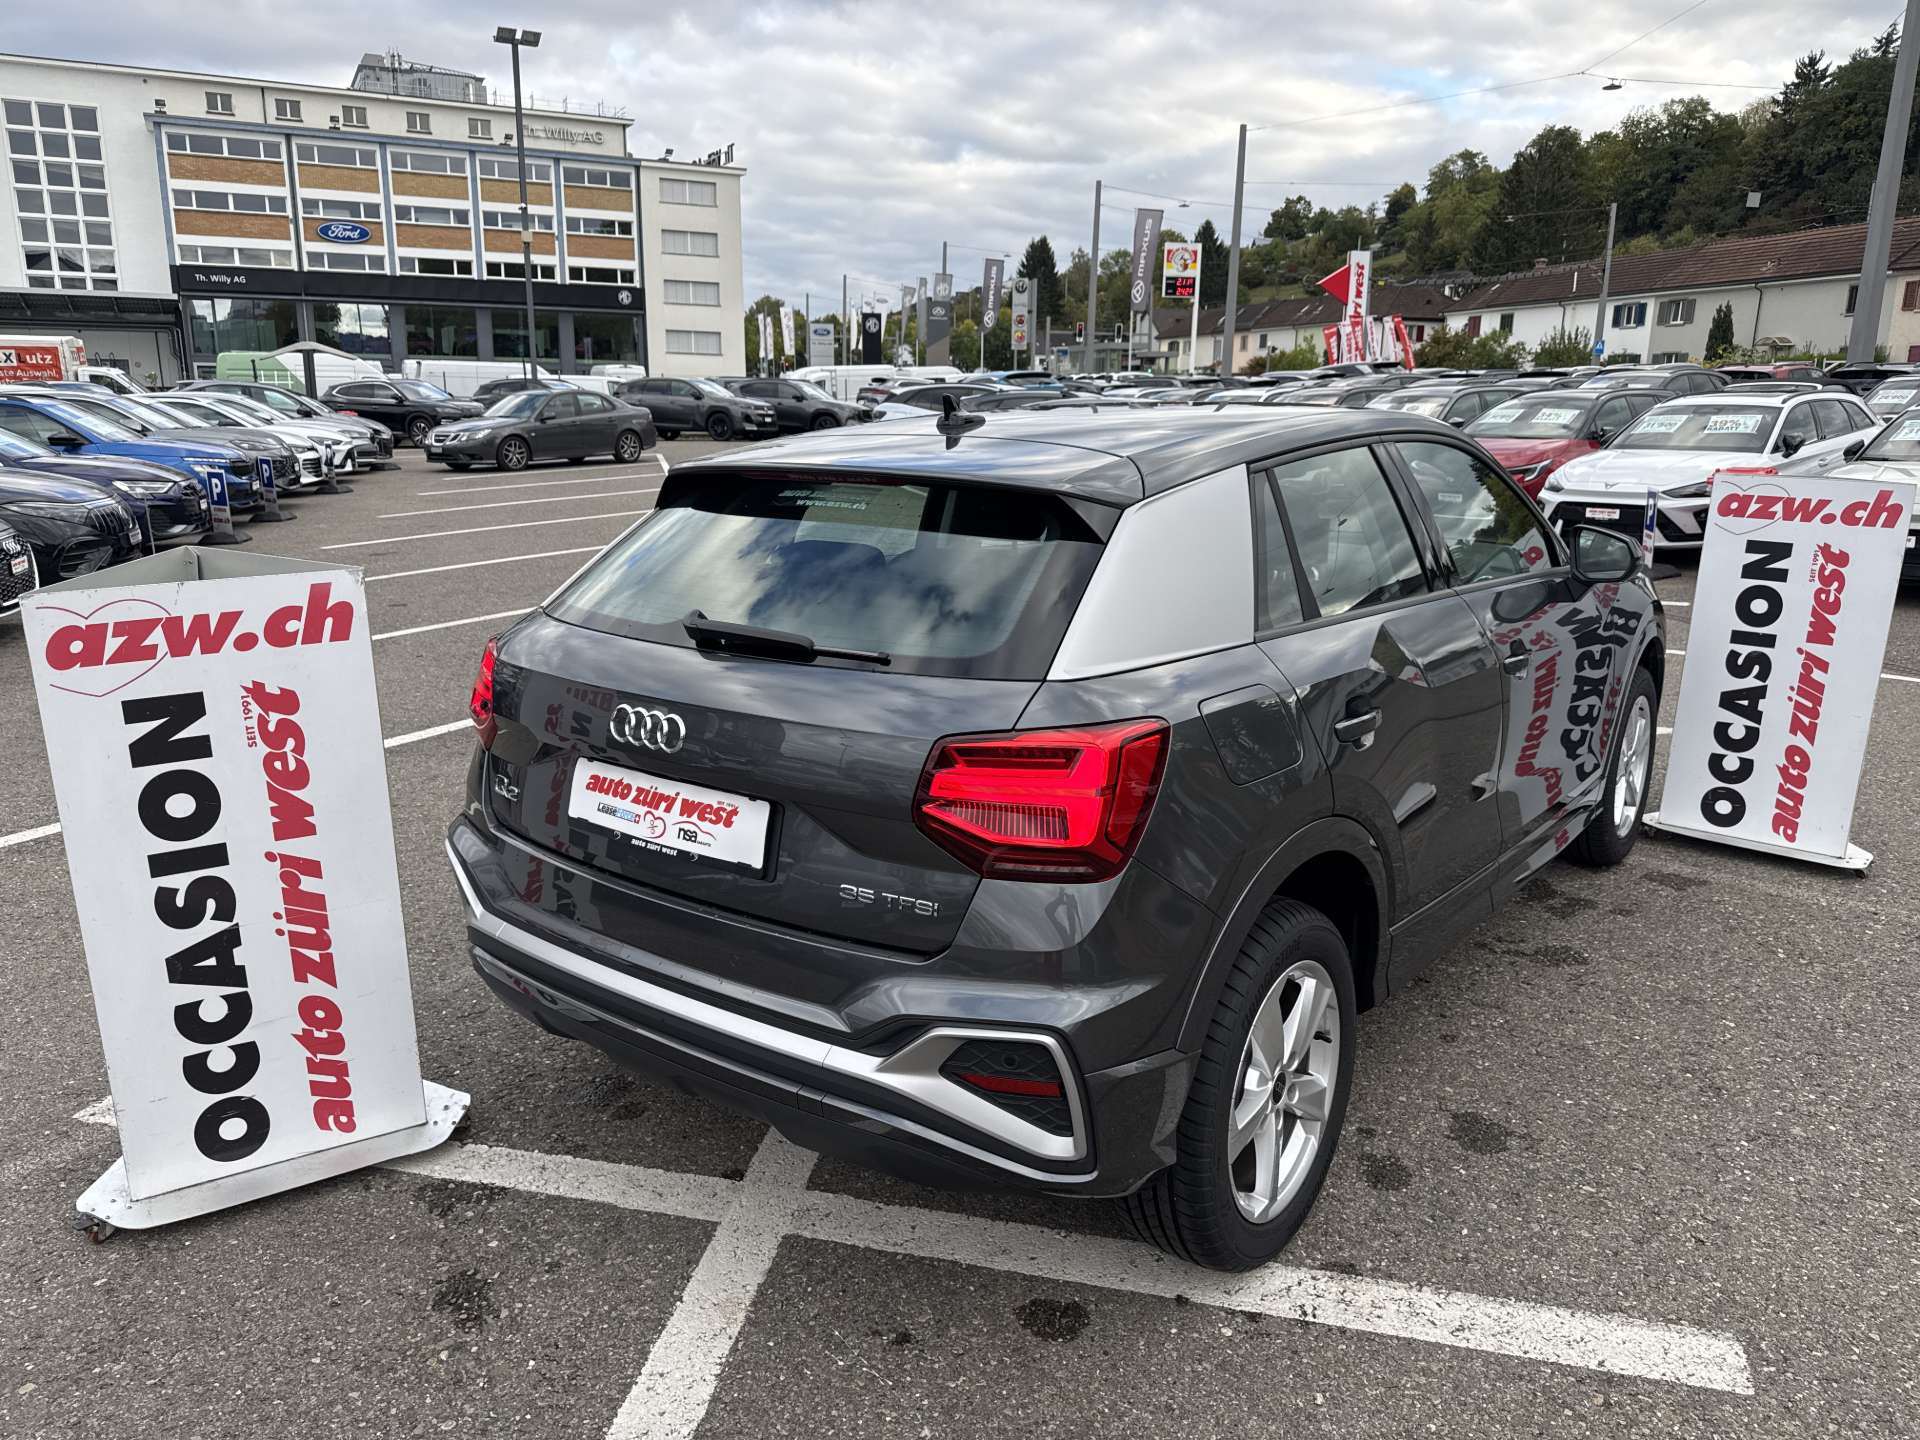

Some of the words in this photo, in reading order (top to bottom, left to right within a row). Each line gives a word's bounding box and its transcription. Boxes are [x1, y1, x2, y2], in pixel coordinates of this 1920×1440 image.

[544, 126, 579, 145] Willy
[582, 130, 605, 144] AG
[328, 224, 361, 239] Ford
[195, 273, 208, 282] Th.
[210, 275, 231, 284] Willy
[211, 477, 221, 501] P
[262, 463, 270, 484] P
[1717, 490, 1904, 529] azw.ch
[1809, 567, 1817, 583] SEIT
[1805, 543, 1850, 646] west
[45, 582, 354, 671] azw.ch
[1700, 540, 1794, 828] OCCASION
[1787, 647, 1830, 747] züri
[240, 694, 254, 722] 1991
[245, 724, 258, 748] SEIT
[240, 680, 317, 841] west
[495, 774, 521, 801] Q2
[586, 774, 632, 800] auto
[631, 786, 680, 813] züri
[679, 798, 740, 828] west
[1772, 744, 1811, 843] auto
[631, 838, 646, 847] auto
[662, 846, 678, 856] west
[678, 827, 698, 843] nsa
[840, 884, 874, 904] 35
[882, 892, 939, 917] TFSI
[121, 691, 270, 1162] OCCASION
[264, 851, 338, 989] züri
[291, 995, 357, 1134] auto
